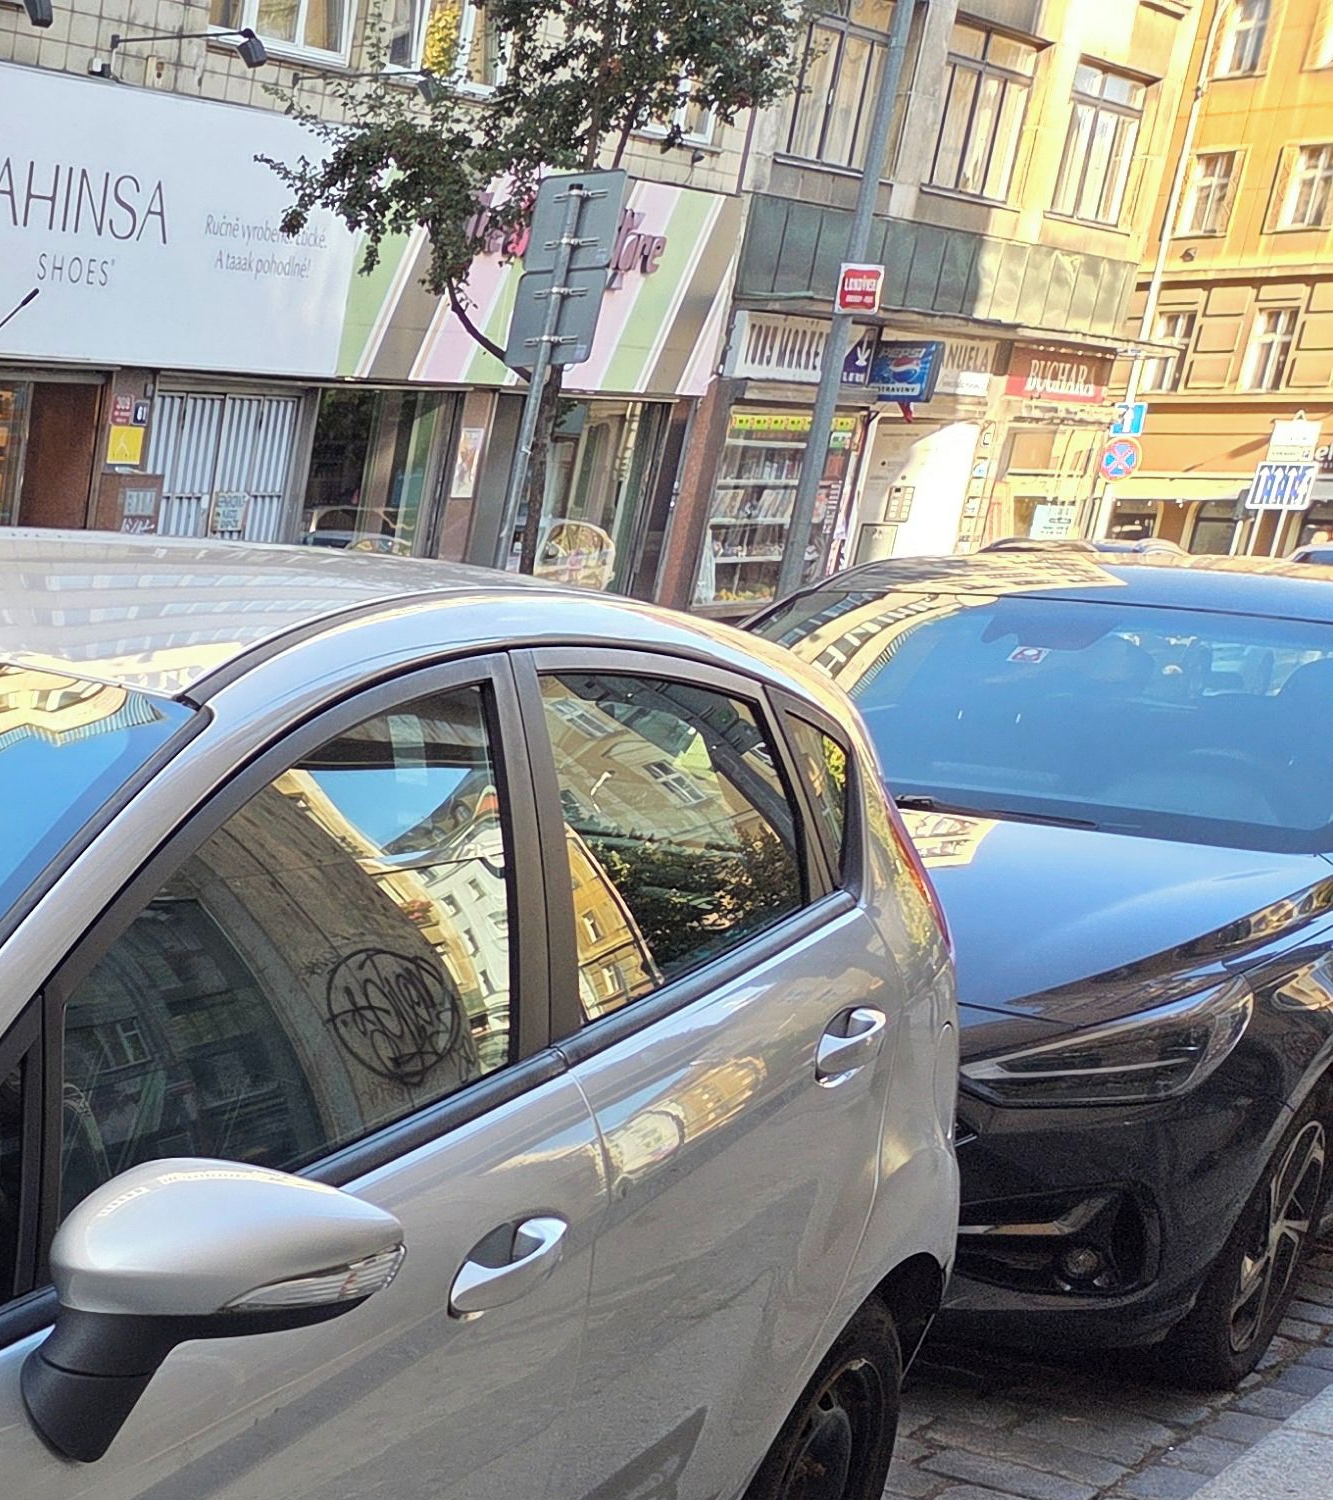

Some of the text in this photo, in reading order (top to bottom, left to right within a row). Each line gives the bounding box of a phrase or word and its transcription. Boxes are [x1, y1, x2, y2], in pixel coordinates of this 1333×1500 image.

[205, 213, 240, 239] Ručně
[37, 252, 110, 287] SHOES
[214, 249, 311, 280] A taaak pohodlné!
[942, 344, 989, 373] NUELA
[877, 385, 916, 394] TRAVINY
[1024, 359, 1096, 398] BUCHARA
